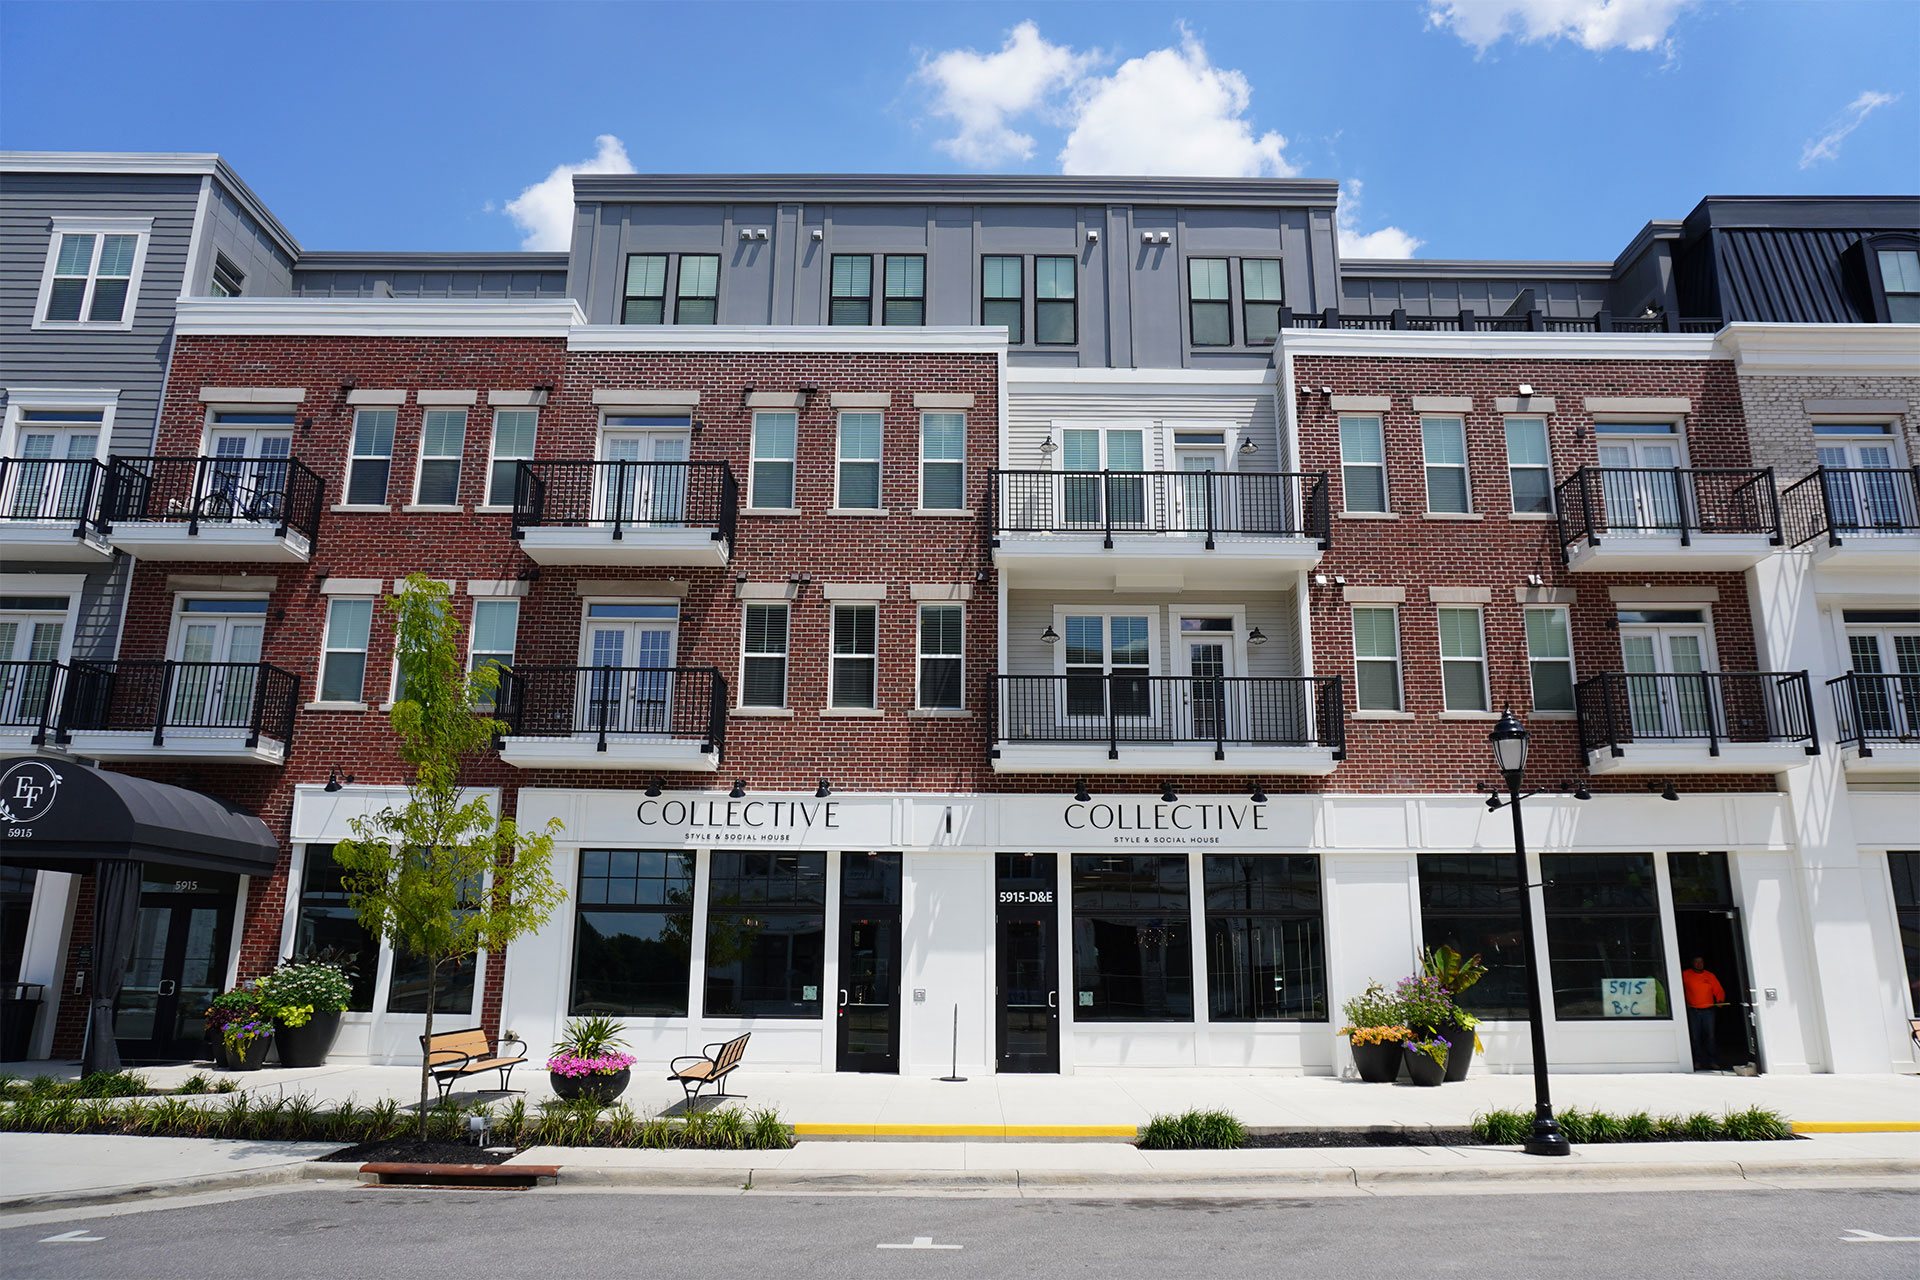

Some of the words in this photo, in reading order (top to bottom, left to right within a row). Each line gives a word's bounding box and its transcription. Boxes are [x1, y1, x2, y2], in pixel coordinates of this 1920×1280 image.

[13, 775, 44, 809] EF
[637, 800, 840, 828] COLLECTIVE
[1064, 804, 1269, 830] COLLECTIVE
[7, 828, 33, 838] 5915
[724, 833, 757, 841] SOCIAL
[1153, 836, 1187, 844] SOCIAL
[1190, 836, 1220, 844] HOUSE
[175, 880, 198, 890] 5915
[999, 891, 1053, 903] 5915-D&E
[1610, 980, 1647, 995] 5915
